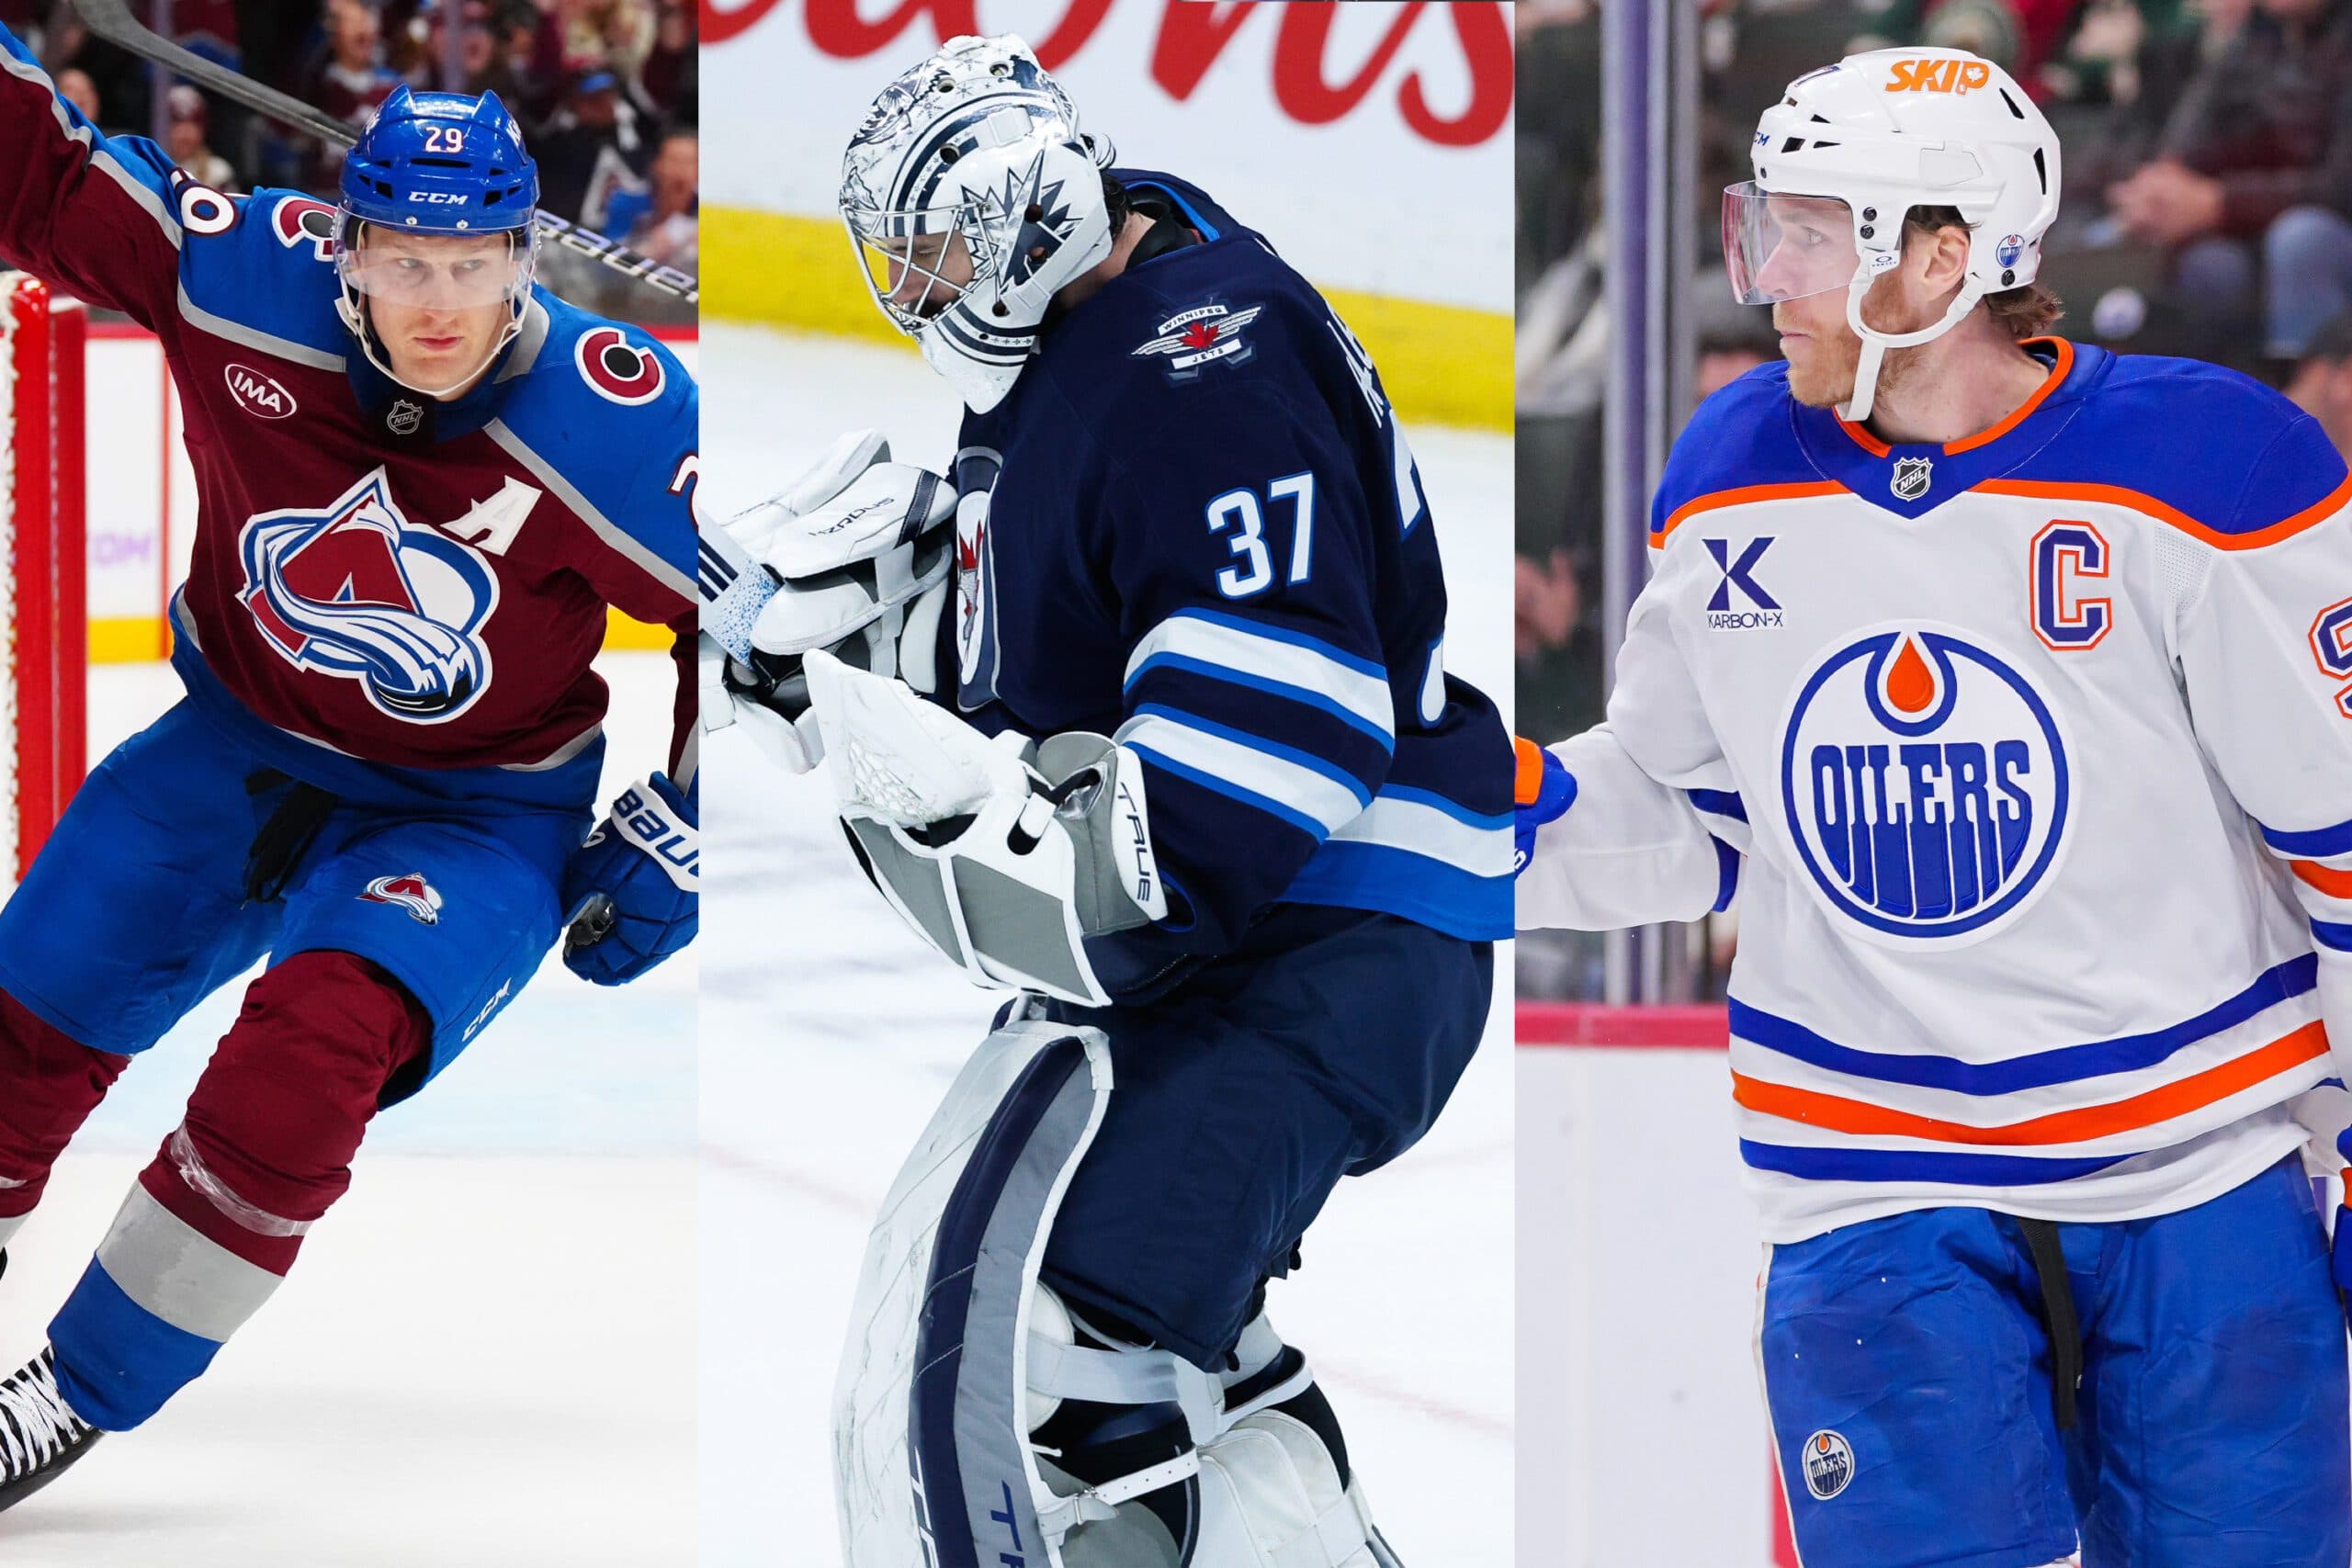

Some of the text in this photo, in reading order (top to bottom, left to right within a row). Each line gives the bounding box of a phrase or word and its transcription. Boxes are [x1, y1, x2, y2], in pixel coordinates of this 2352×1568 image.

[1884, 60, 1990, 96] SKIP
[424, 126, 464, 153] 29
[408, 191, 469, 206] CCM
[1162, 306, 1224, 331] WINNIPEG
[1192, 346, 1225, 364] JETS
[233, 371, 281, 412] IMA
[394, 413, 416, 425] NHL
[1899, 468, 1927, 492] NHL
[440, 475, 543, 557] A
[1204, 470, 1316, 600] 37
[2029, 519, 2112, 651] C
[1708, 612, 1783, 629] KARBON-X
[1118, 782, 1150, 901] TRUE
[1811, 739, 2033, 919] OILERS
[461, 977, 510, 1042] CCM
[1809, 1451, 1849, 1495] OILERS
